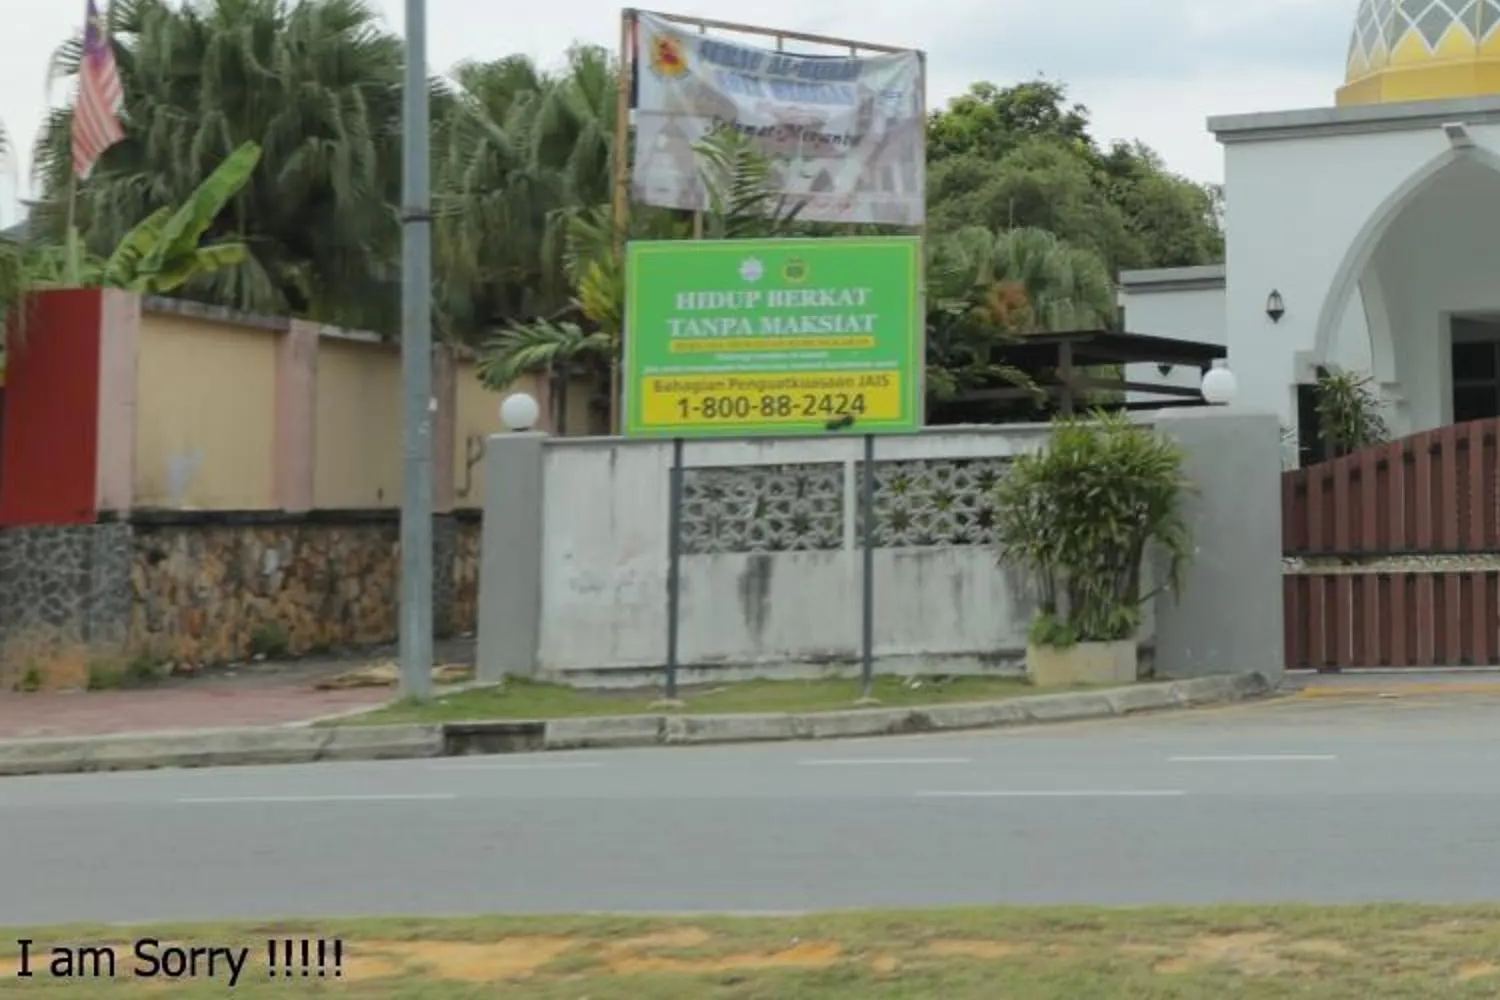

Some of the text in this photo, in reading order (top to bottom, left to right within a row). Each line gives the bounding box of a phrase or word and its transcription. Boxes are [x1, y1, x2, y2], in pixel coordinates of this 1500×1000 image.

[675, 287, 871, 310] HIDUP BERKAT
[667, 313, 878, 338] TANPA MAKSIAT
[857, 373, 890, 388] JAIS
[677, 392, 867, 419] 1-800-88-2424
